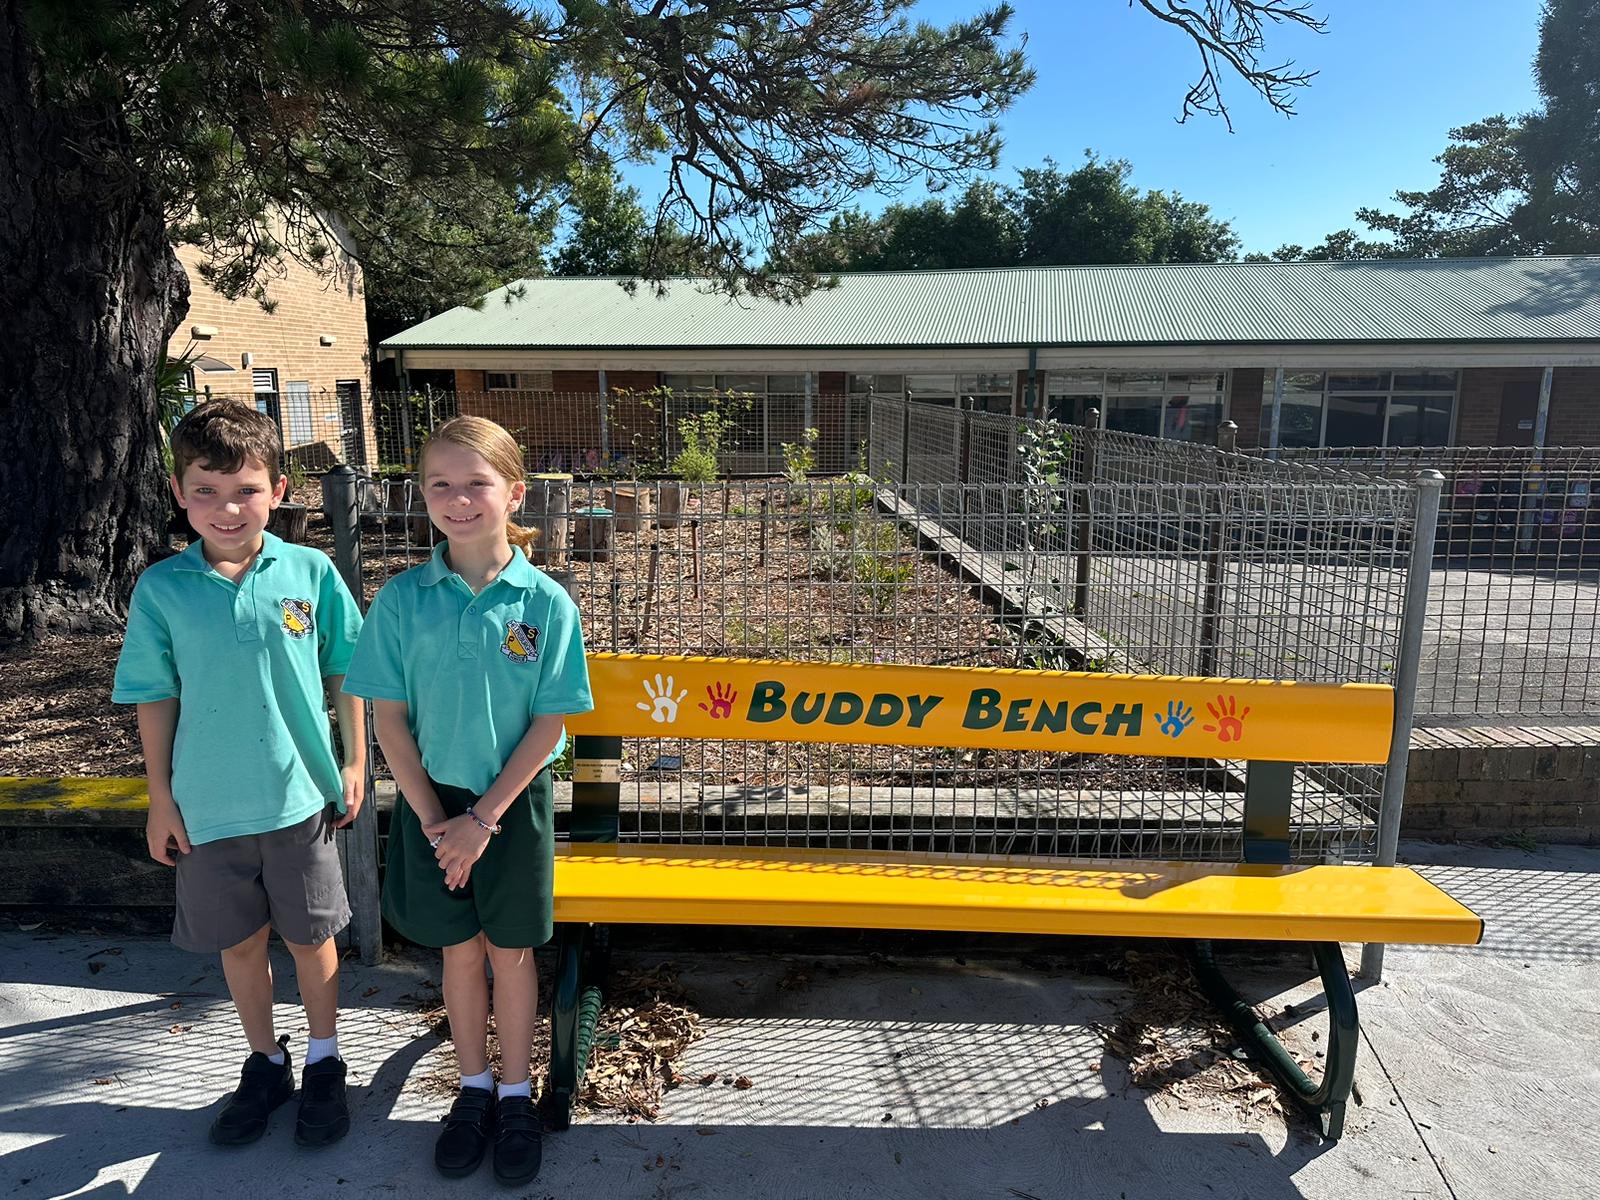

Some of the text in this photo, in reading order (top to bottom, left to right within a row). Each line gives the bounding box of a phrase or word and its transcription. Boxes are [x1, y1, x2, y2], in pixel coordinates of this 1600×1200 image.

[302, 602, 310, 612] S
[527, 629, 535, 638] S
[747, 681, 1143, 736] BUDDY BENCH
